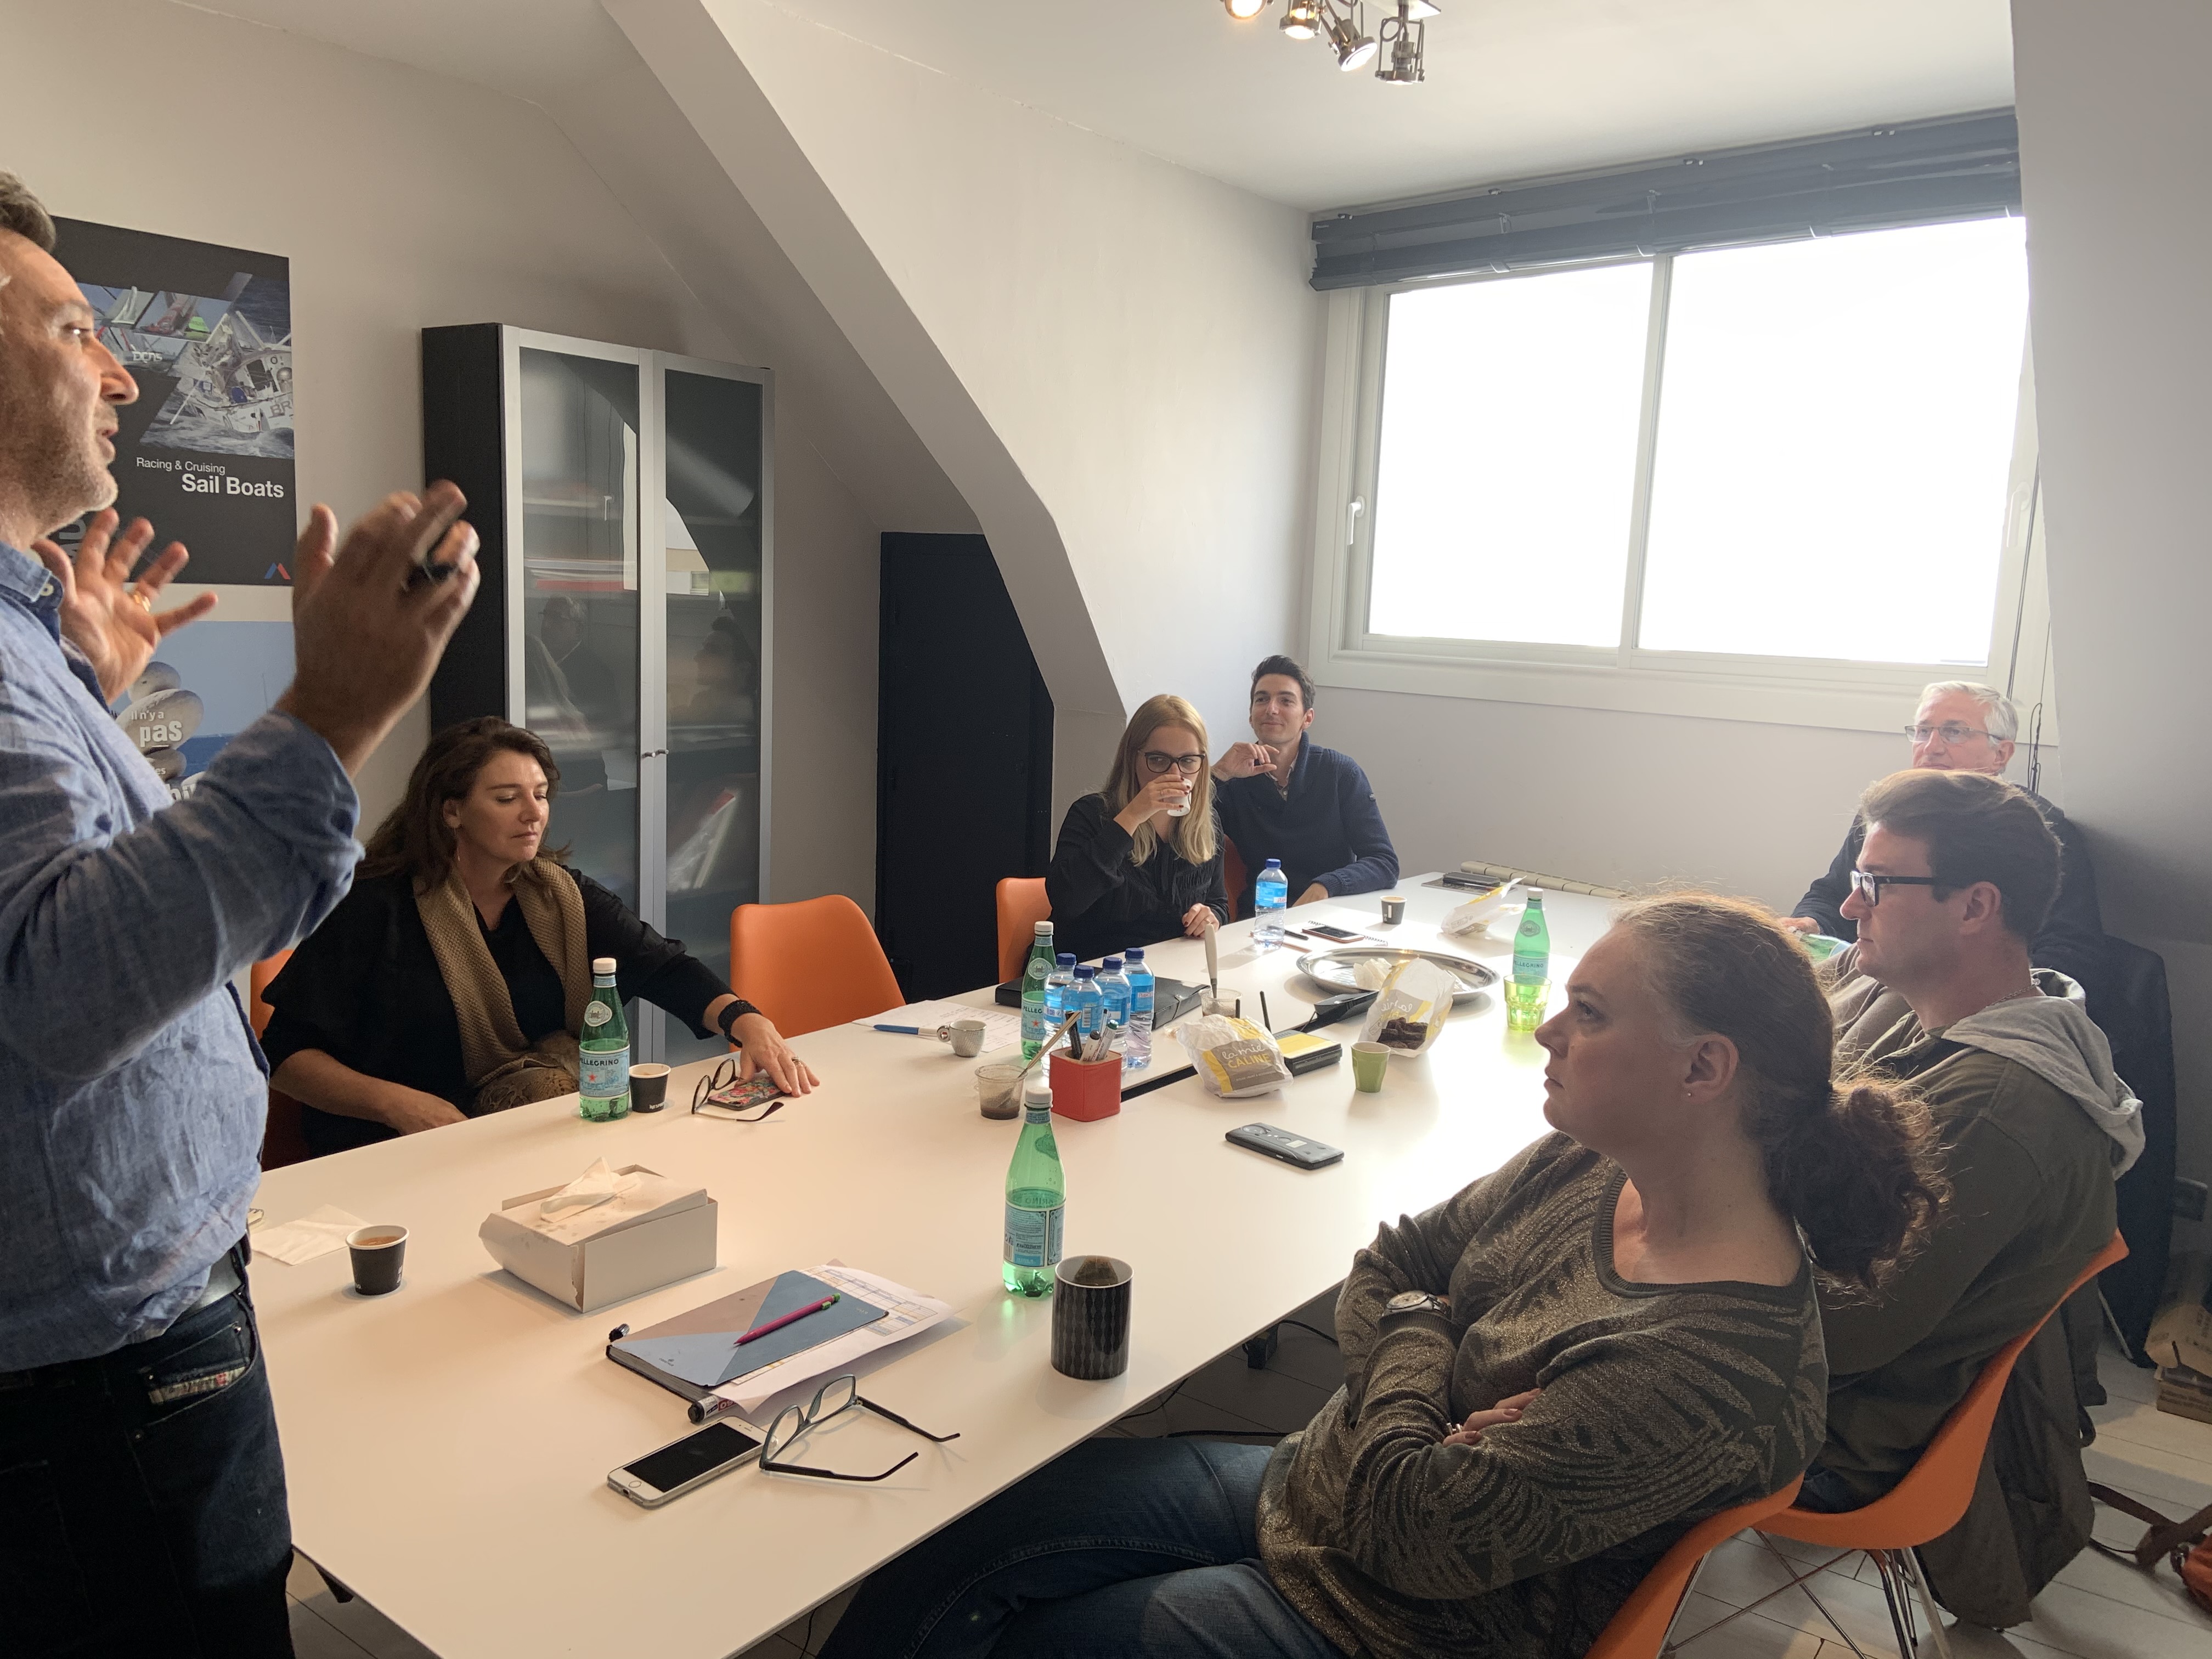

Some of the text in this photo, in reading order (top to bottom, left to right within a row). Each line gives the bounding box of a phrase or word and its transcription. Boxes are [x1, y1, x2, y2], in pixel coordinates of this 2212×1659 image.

[270, 399, 293, 418] BR
[136, 457, 226, 476] Racing & Cruising
[182, 473, 285, 498] Sail Boats
[140, 720, 183, 747] pas
[1222, 1044, 1265, 1059] la mie
